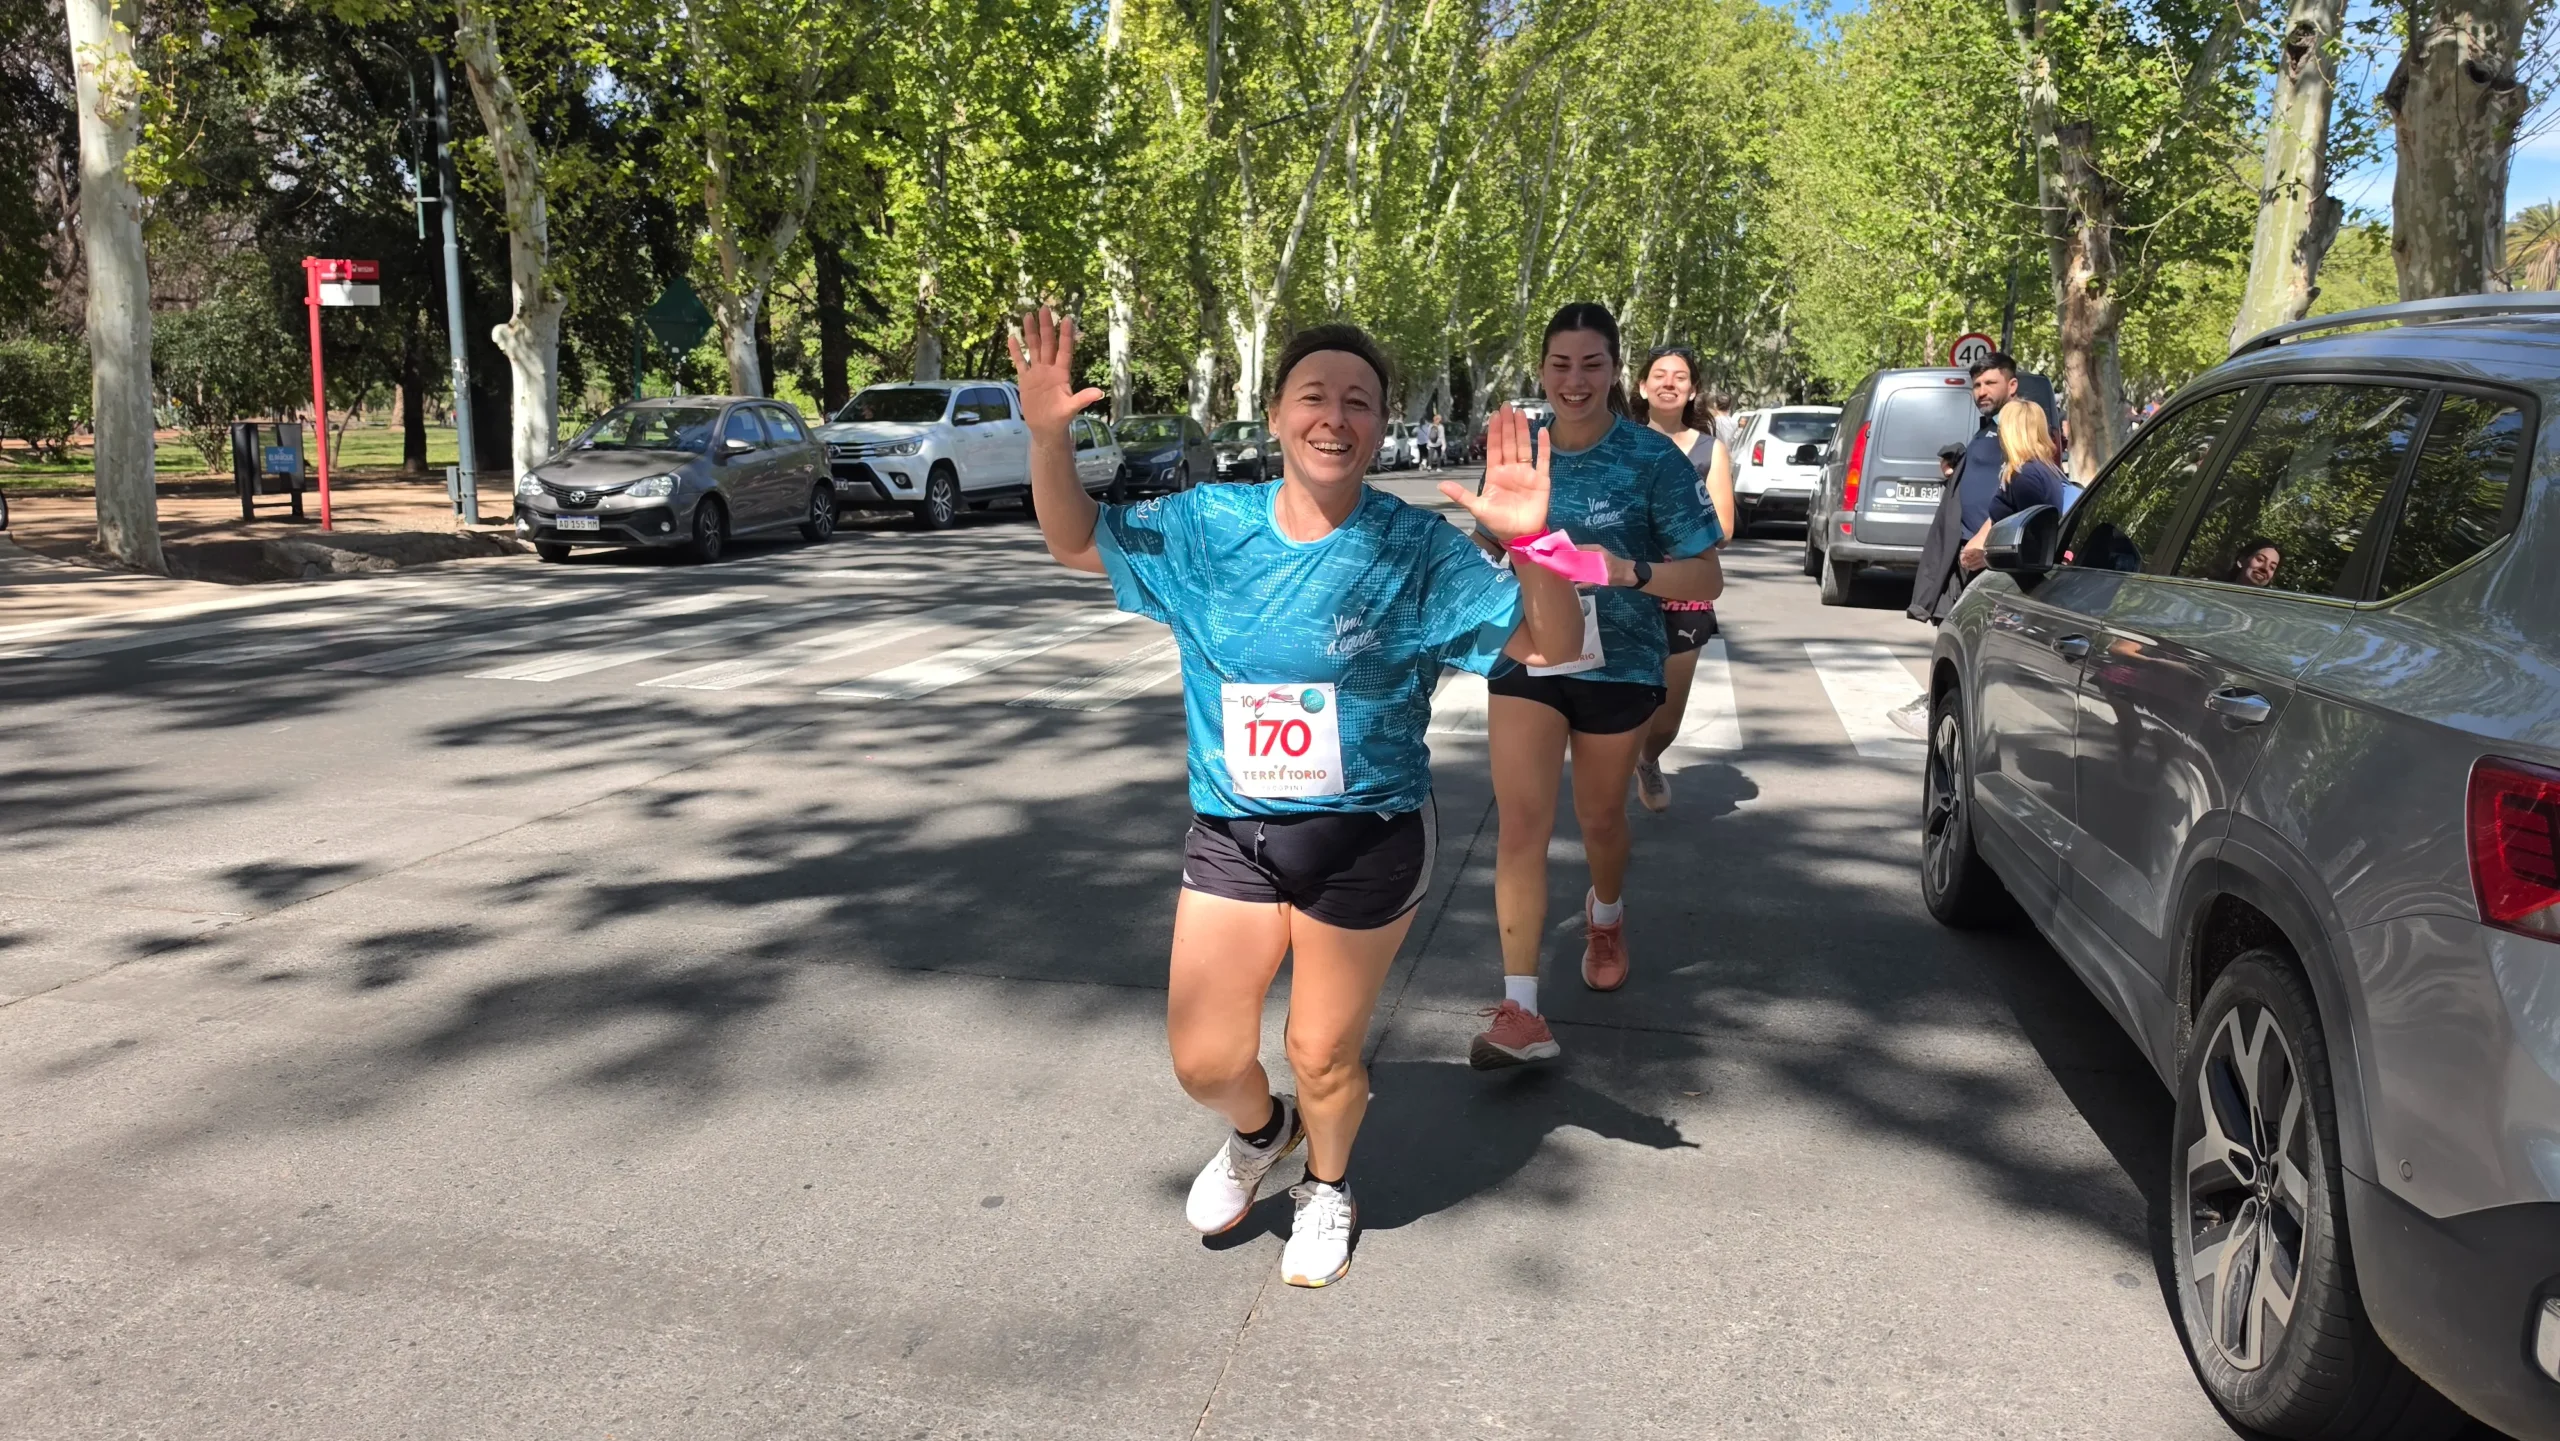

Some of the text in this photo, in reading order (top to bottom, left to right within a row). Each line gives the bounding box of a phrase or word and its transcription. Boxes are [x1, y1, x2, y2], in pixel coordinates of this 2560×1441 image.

[1959, 344, 1987, 364] 40
[1898, 486, 1939, 500] LPA 632
[559, 520, 598, 529] AD 155 MM
[1244, 719, 1312, 758] 170
